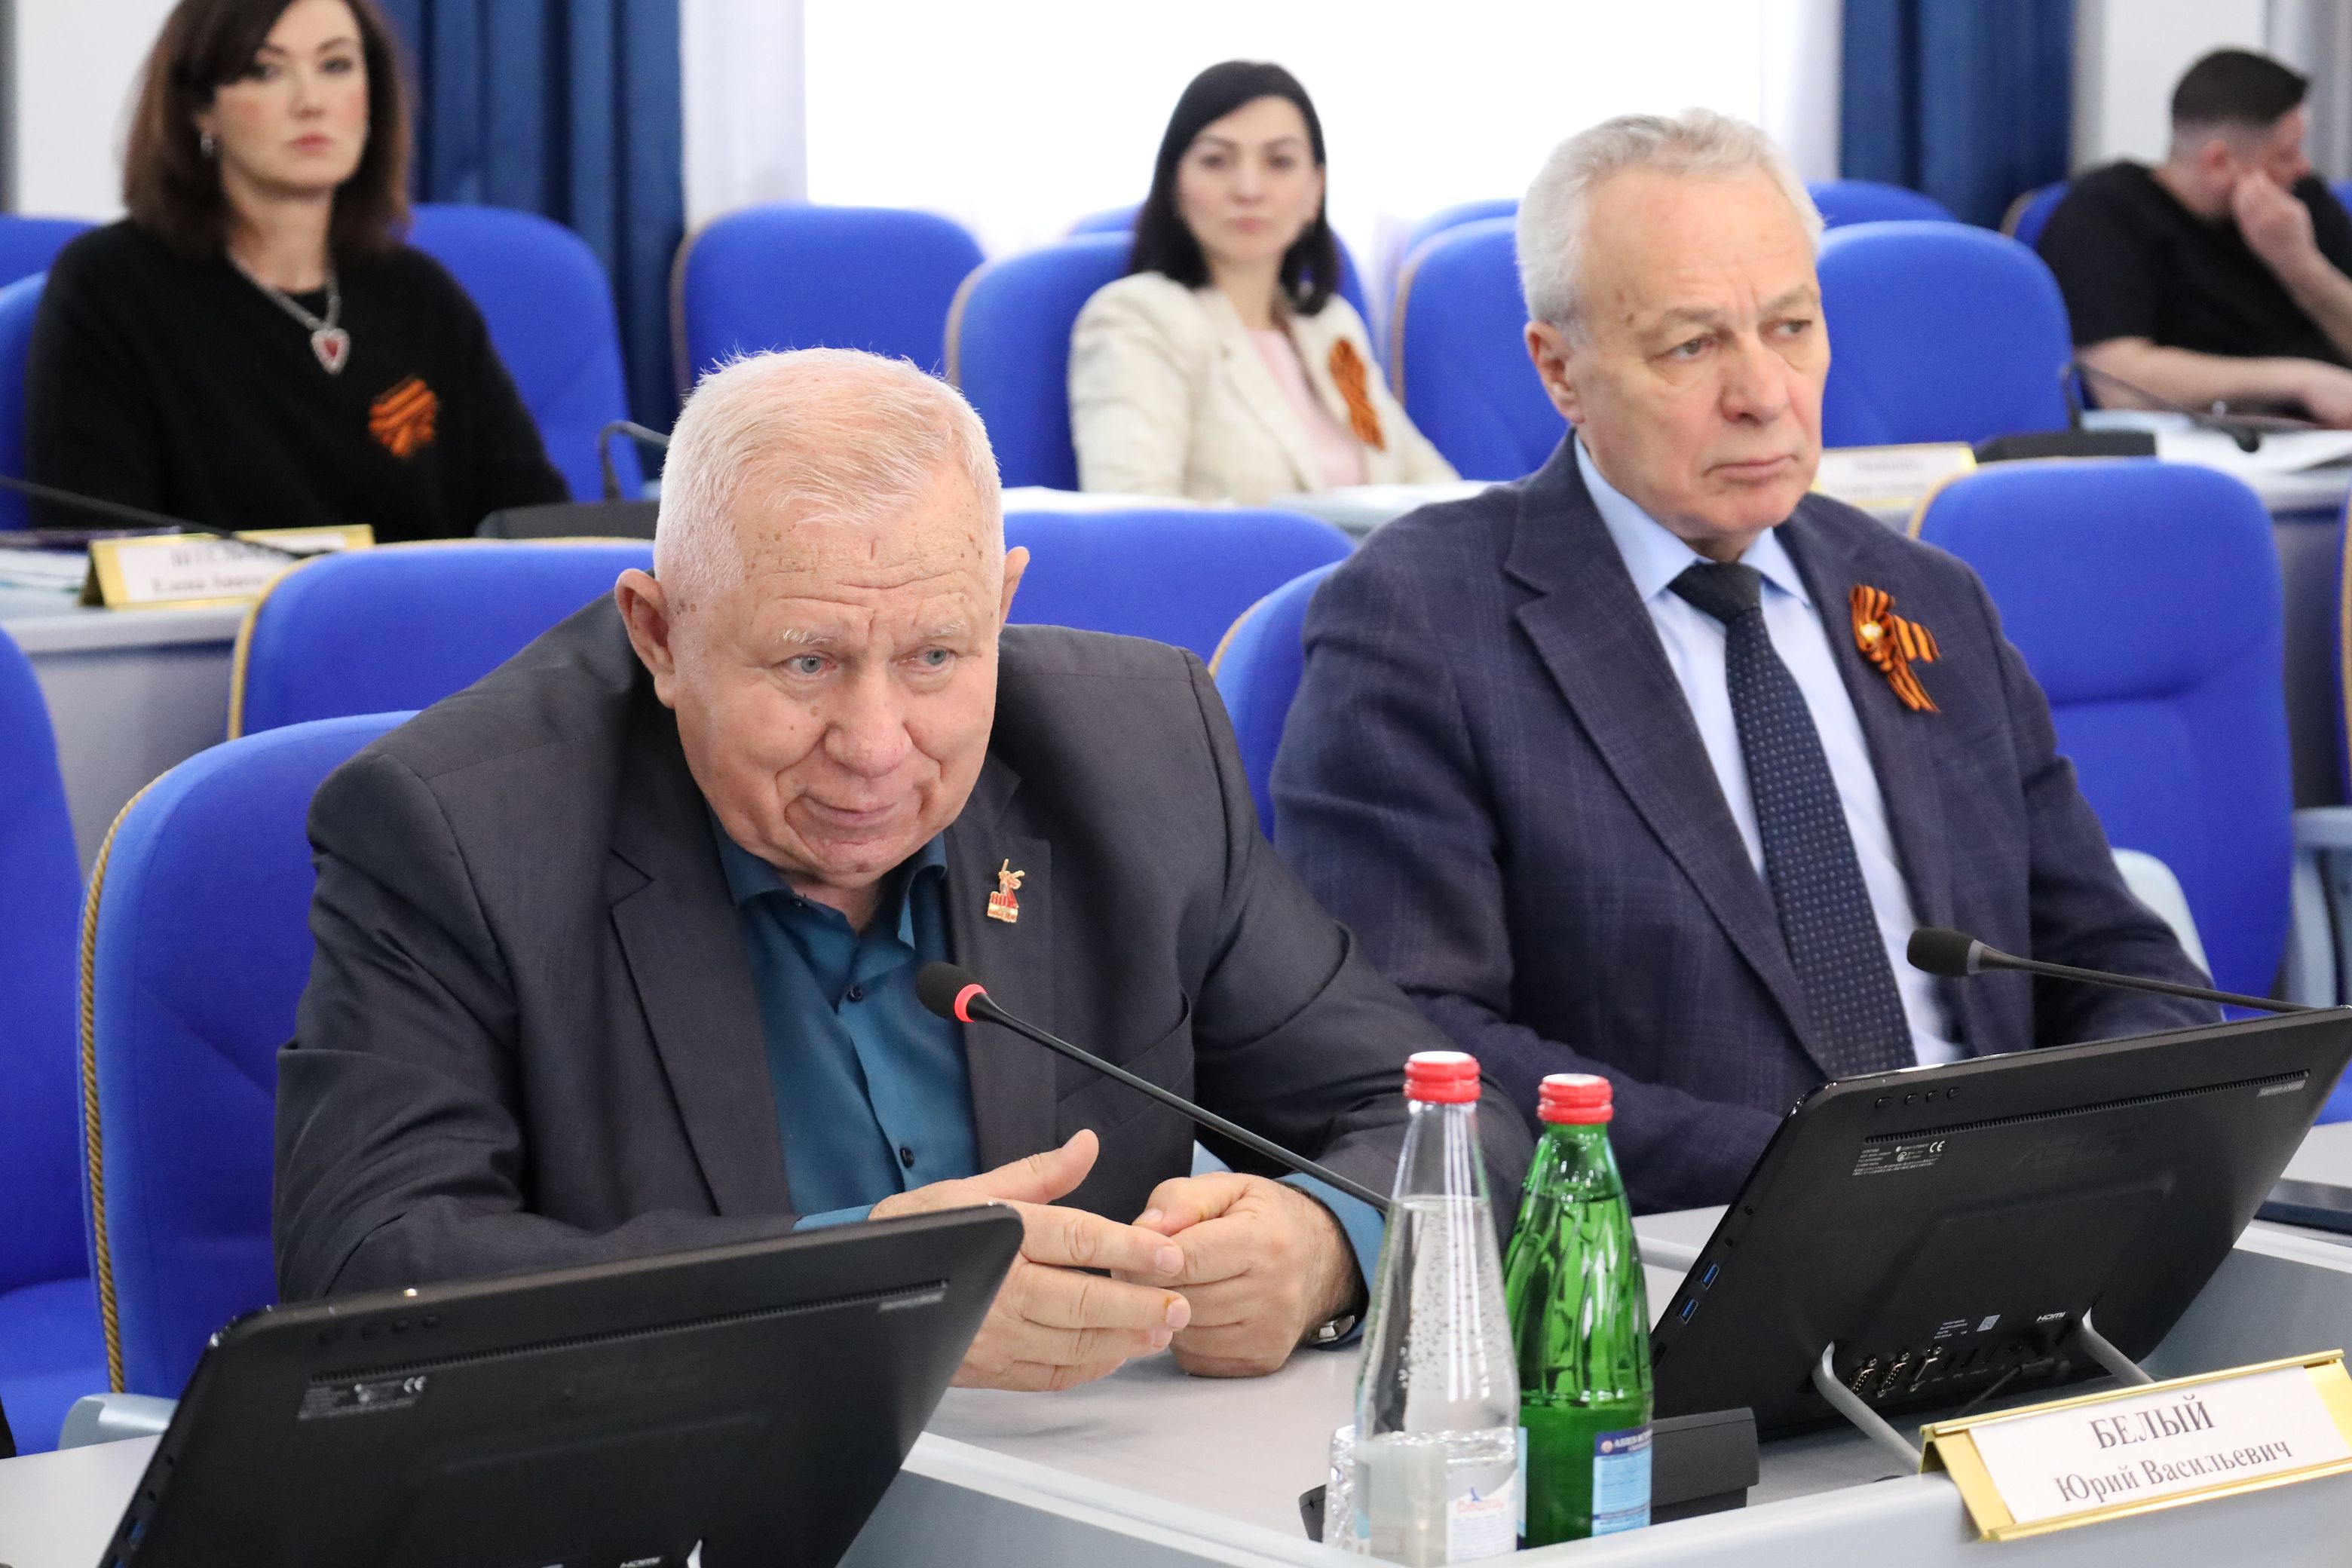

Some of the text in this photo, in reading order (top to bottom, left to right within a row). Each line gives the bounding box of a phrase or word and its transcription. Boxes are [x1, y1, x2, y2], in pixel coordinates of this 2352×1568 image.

[2036, 1311, 2067, 1322] HDMI
[2088, 1393, 2217, 1450] БЕЛЫЙ
[2053, 1441, 2293, 1503] Юрий Васильевич
